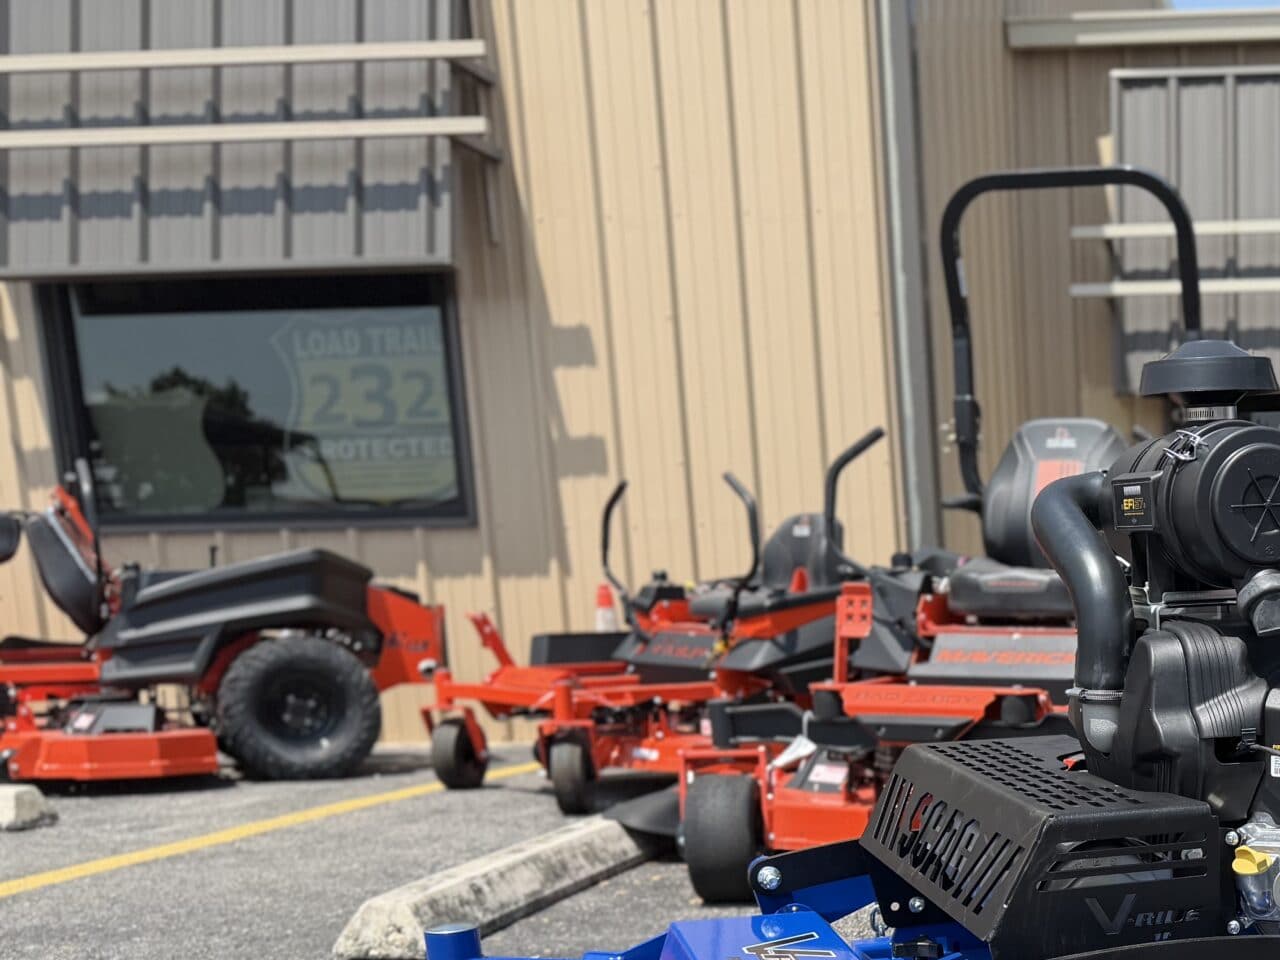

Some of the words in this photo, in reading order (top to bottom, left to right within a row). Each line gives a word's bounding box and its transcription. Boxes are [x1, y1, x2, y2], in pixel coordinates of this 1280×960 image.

[293, 328, 360, 358] LOAD
[310, 363, 440, 429] 232
[302, 436, 452, 461] ROTECTED
